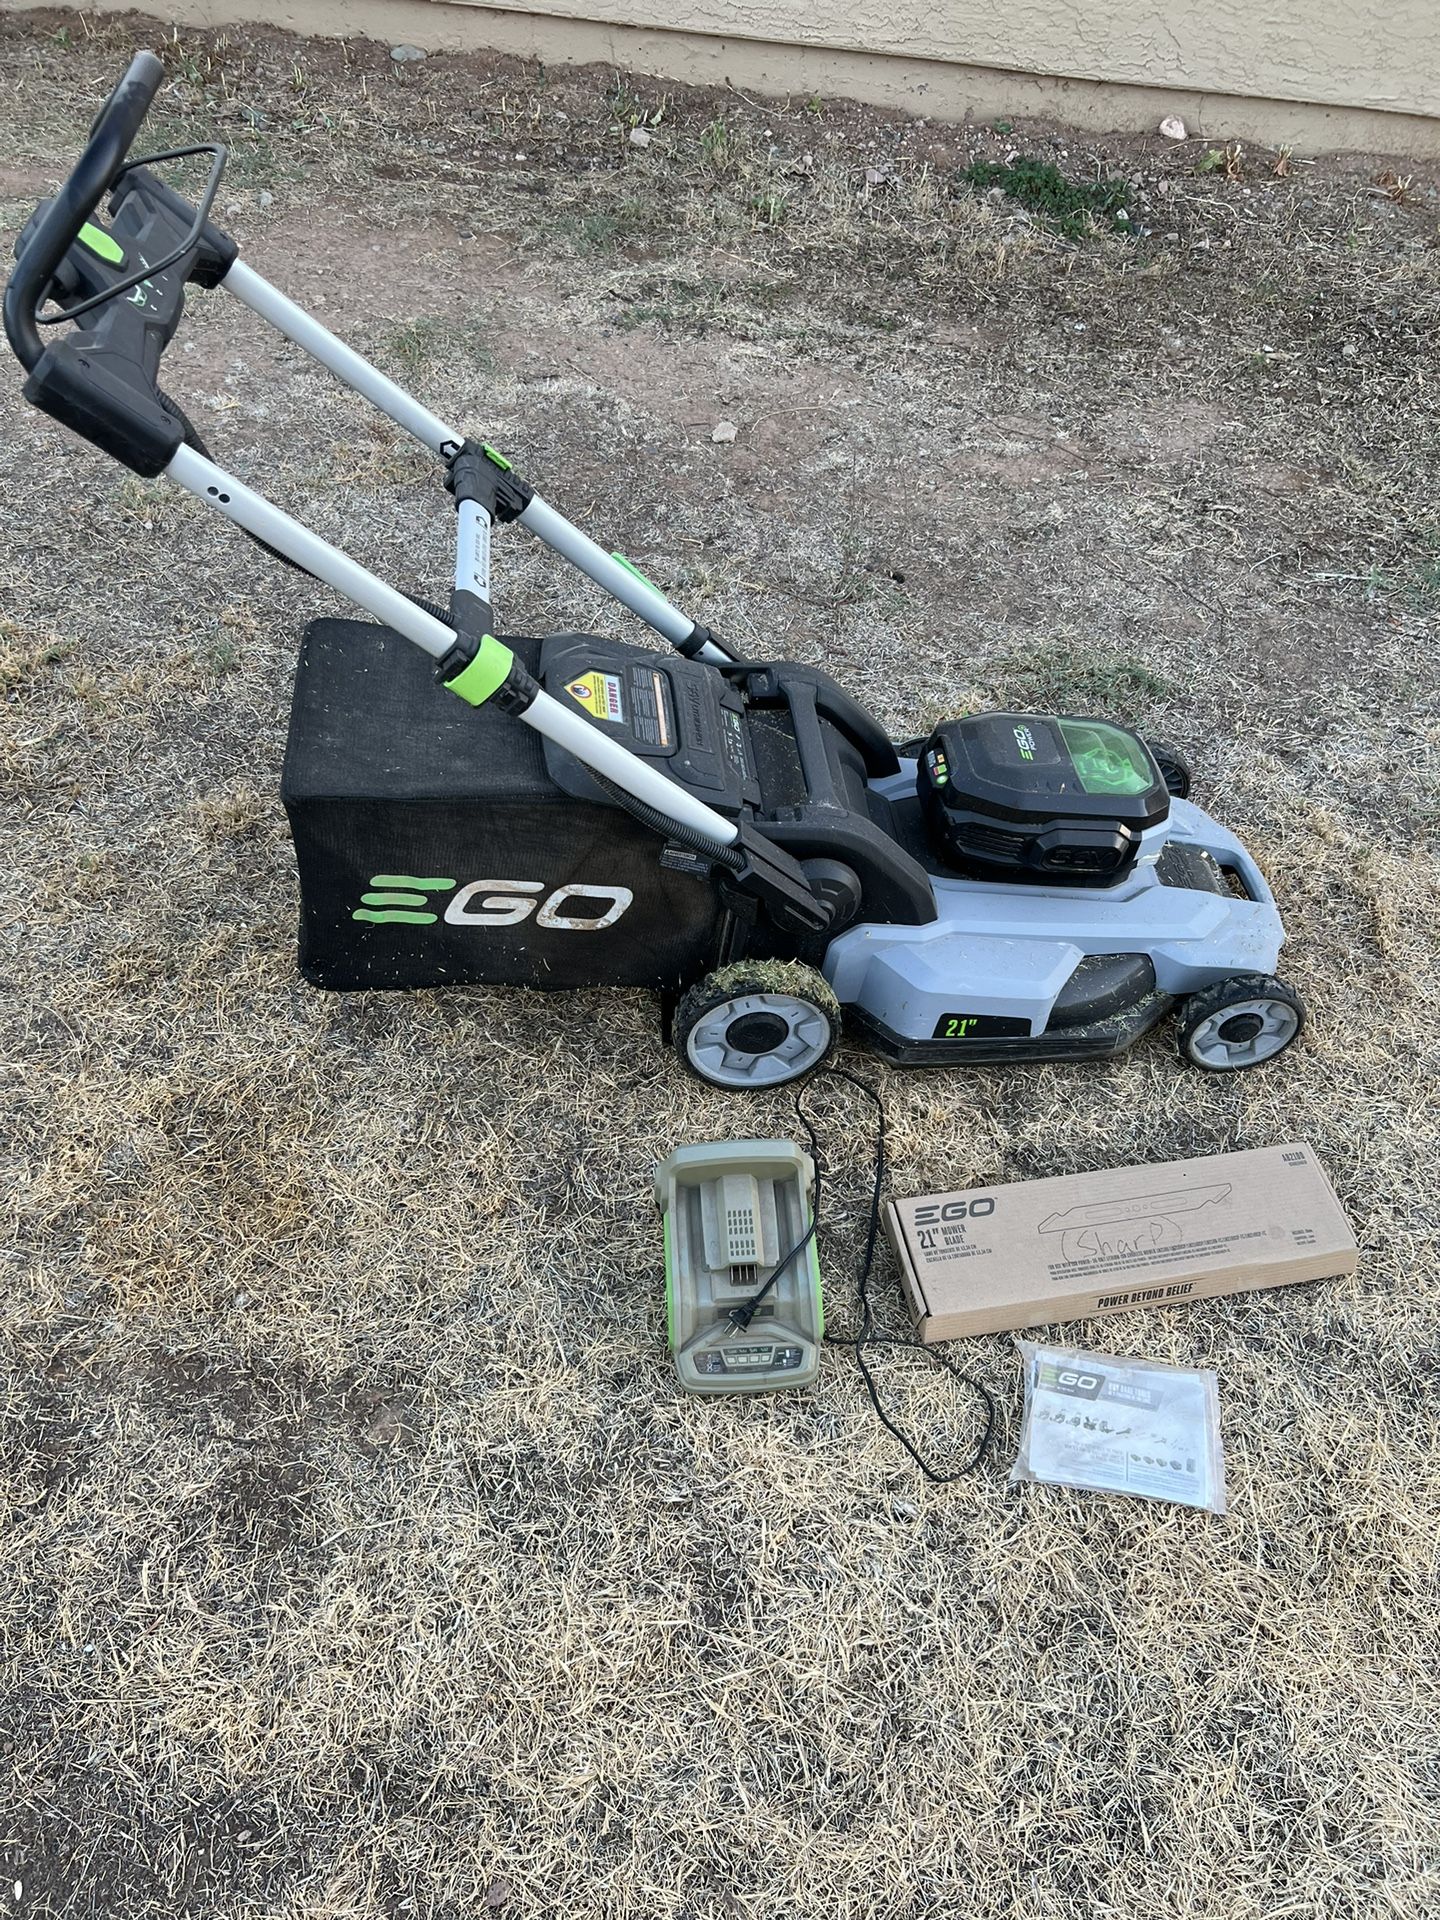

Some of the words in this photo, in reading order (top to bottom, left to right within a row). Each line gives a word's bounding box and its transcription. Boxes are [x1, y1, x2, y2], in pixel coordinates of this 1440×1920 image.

[607, 681, 619, 714] DANGER
[1013, 729, 1034, 761] EGO
[351, 874, 635, 931] EGO
[945, 1019, 978, 1037] 21"
[914, 1197, 995, 1226] EGO
[916, 1227, 939, 1249] 21"
[940, 1223, 967, 1235] MOWER
[943, 1234, 965, 1246] BLADE
[1097, 1294, 1129, 1308] POWER
[1131, 1288, 1164, 1303] BEYOND
[1166, 1282, 1194, 1297] BELIEF
